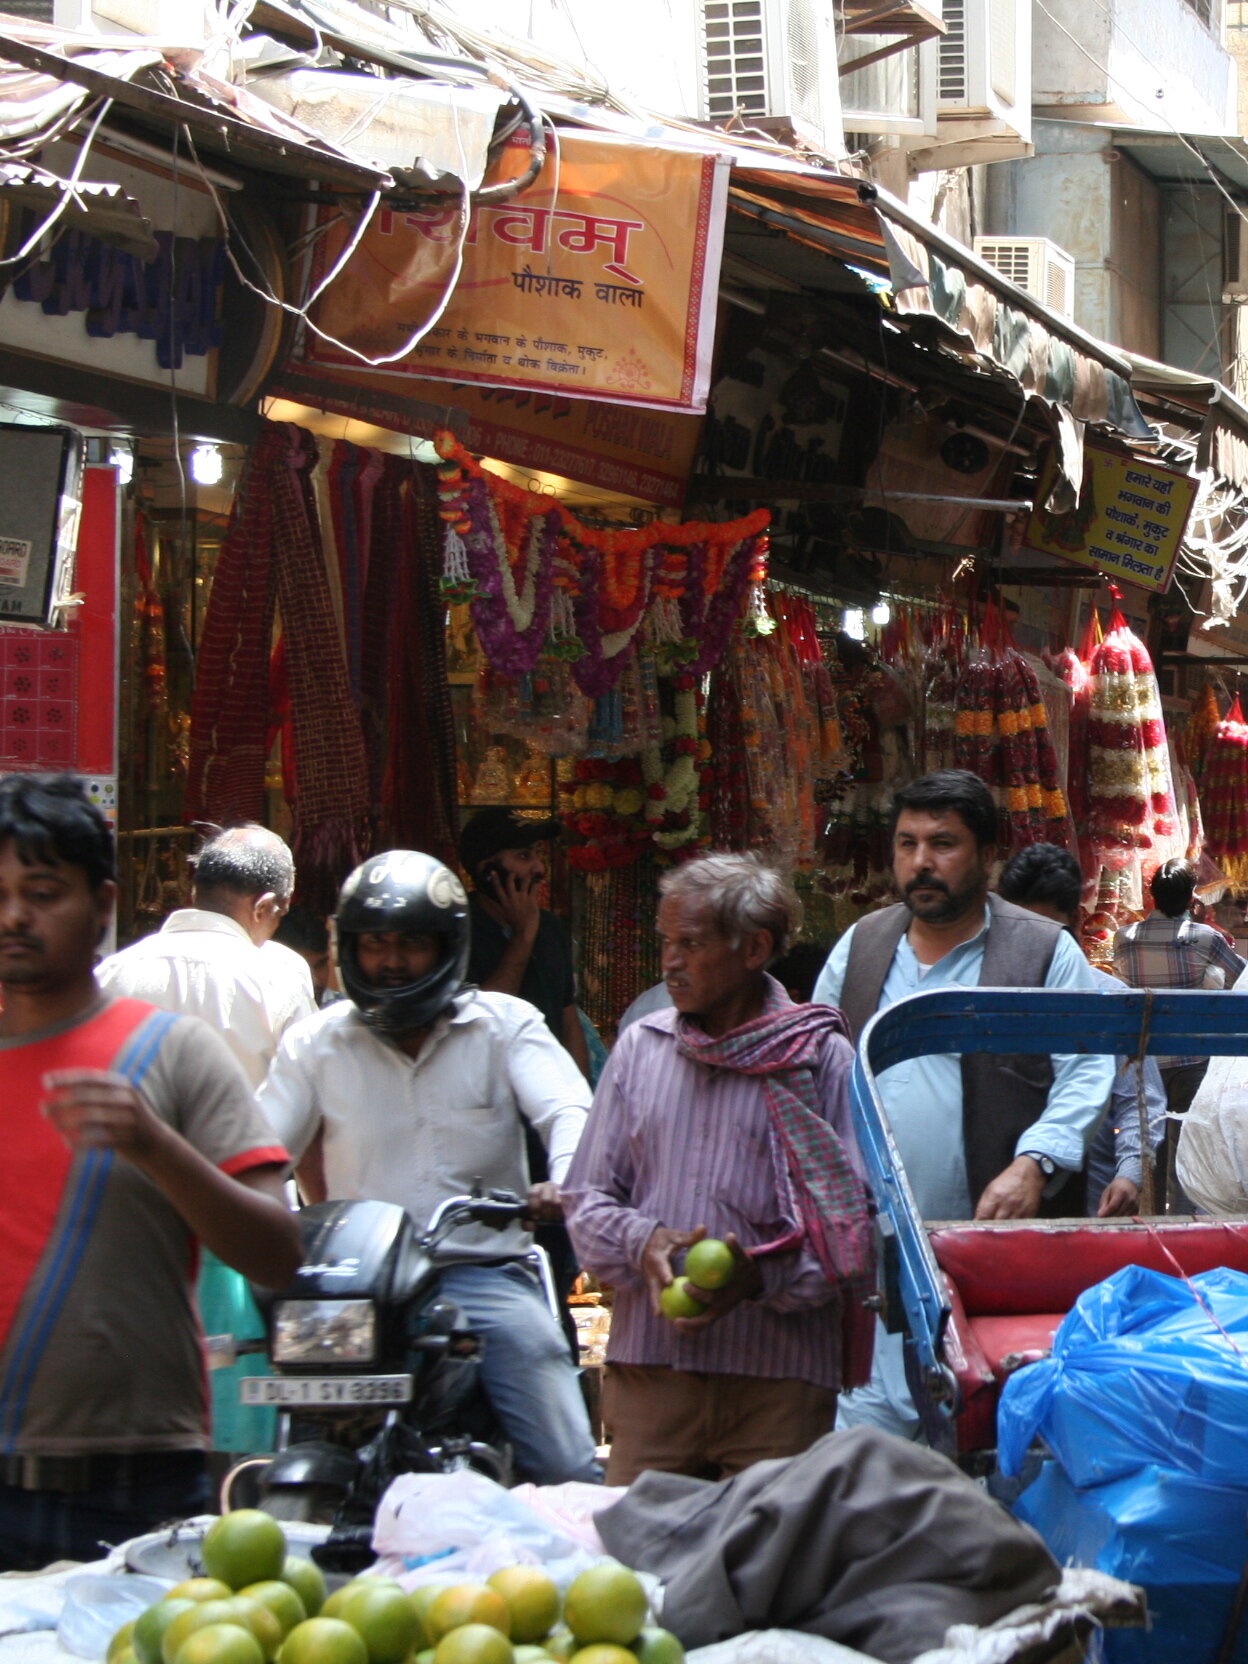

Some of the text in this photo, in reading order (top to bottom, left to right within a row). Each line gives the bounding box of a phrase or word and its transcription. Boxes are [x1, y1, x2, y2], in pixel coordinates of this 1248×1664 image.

[594, 281, 645, 308] वाला
[457, 327, 468, 341] के
[475, 332, 510, 346] भगवान
[515, 334, 527, 348] के
[446, 344, 458, 358] के
[463, 343, 497, 364] निर्माता
[502, 355, 513, 366] व
[1124, 469, 1152, 488] हमारे
[1118, 489, 1172, 517] भगवान की
[1105, 528, 1115, 541] व
[1142, 544, 1160, 558] का
[1142, 519, 1171, 542] मुकुट
[1089, 544, 1166, 583] सामान मिलता है
